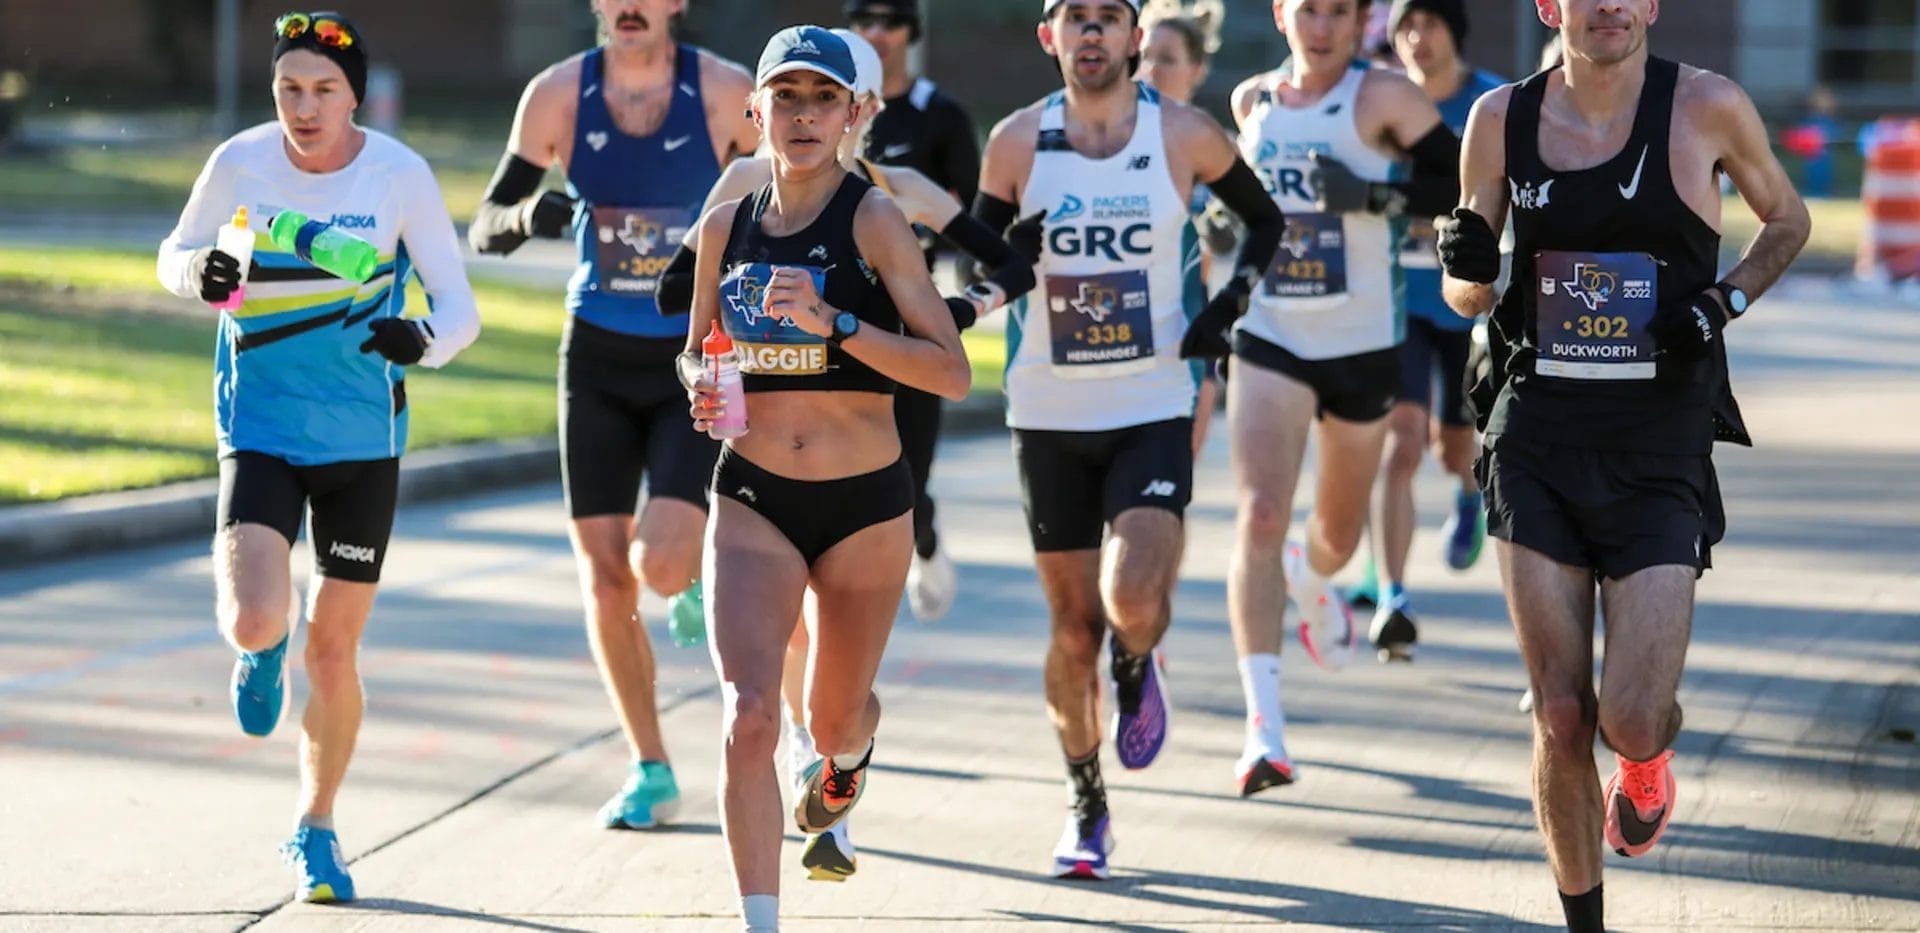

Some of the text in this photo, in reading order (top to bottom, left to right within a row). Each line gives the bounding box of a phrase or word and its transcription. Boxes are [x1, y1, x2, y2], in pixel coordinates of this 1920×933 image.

[330, 214, 376, 228] HOKA
[1049, 222, 1153, 262] GRC
[1623, 288, 1651, 299] 2022
[1087, 324, 1133, 345] 338
[1577, 315, 1629, 338] 302
[1552, 343, 1637, 358] DUCKWORTH
[329, 540, 376, 564] HOKA
